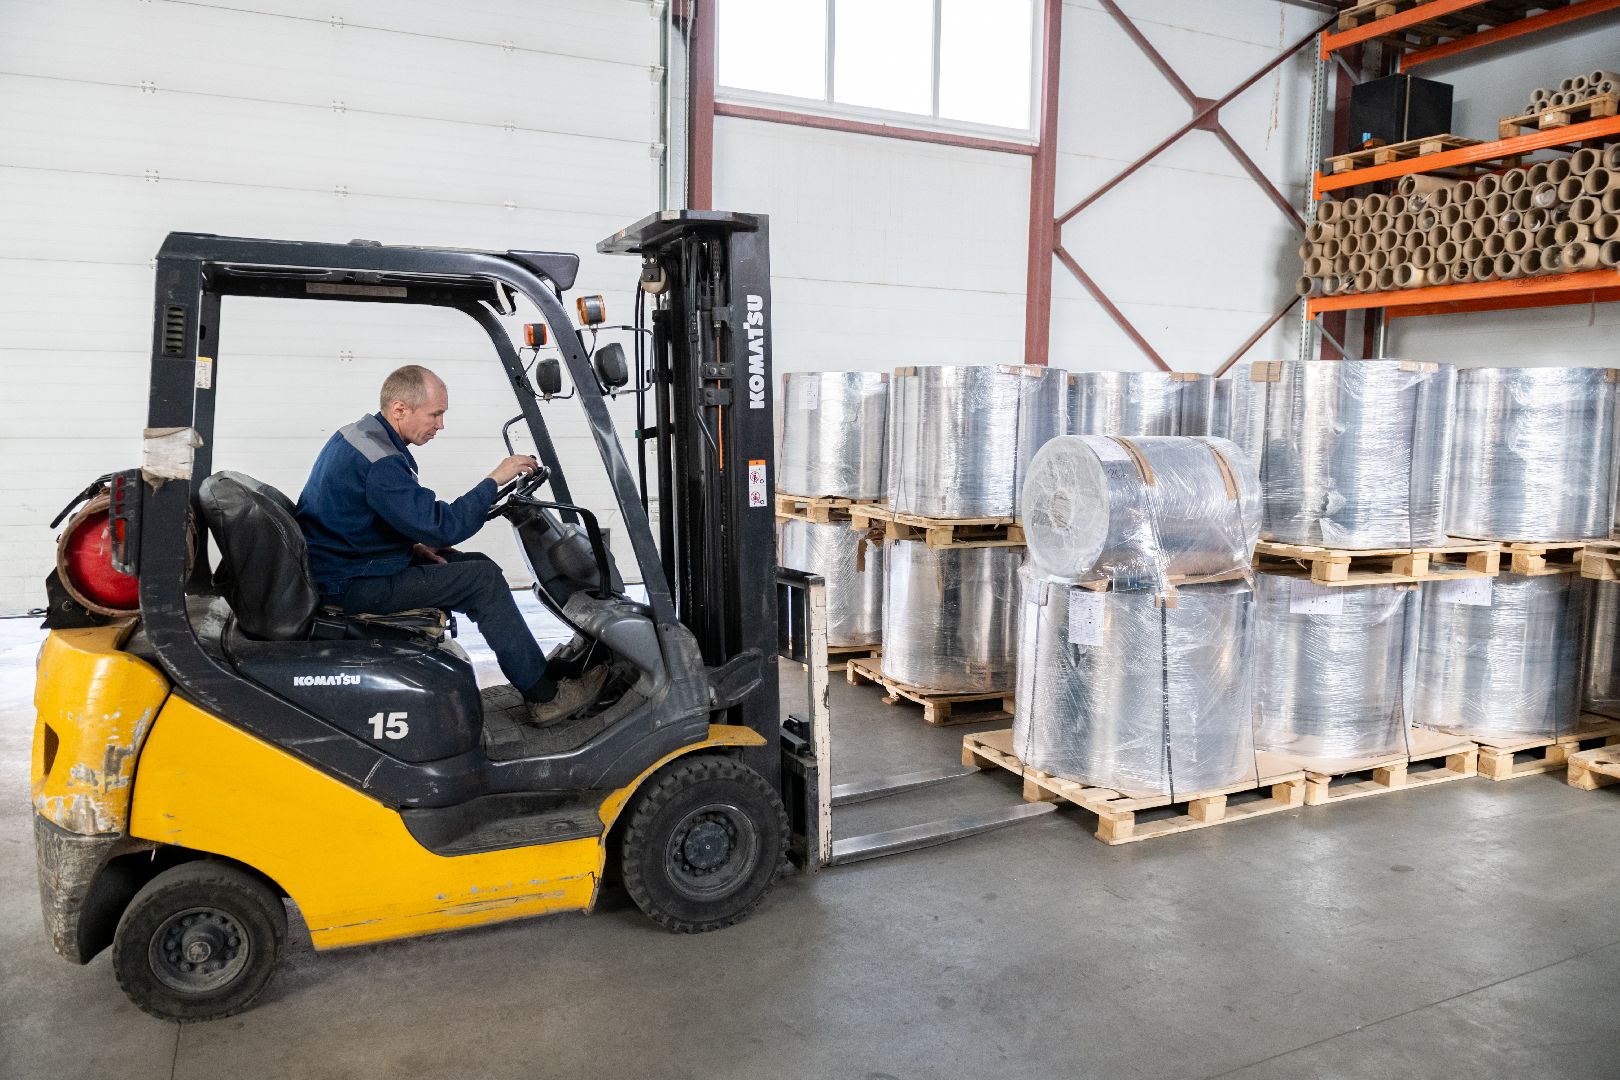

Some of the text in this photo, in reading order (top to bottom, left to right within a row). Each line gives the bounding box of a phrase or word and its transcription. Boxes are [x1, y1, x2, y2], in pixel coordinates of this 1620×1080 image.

[743, 294, 765, 409] KOMATSU
[293, 672, 361, 687] KOMATSU
[368, 712, 410, 740] 15
